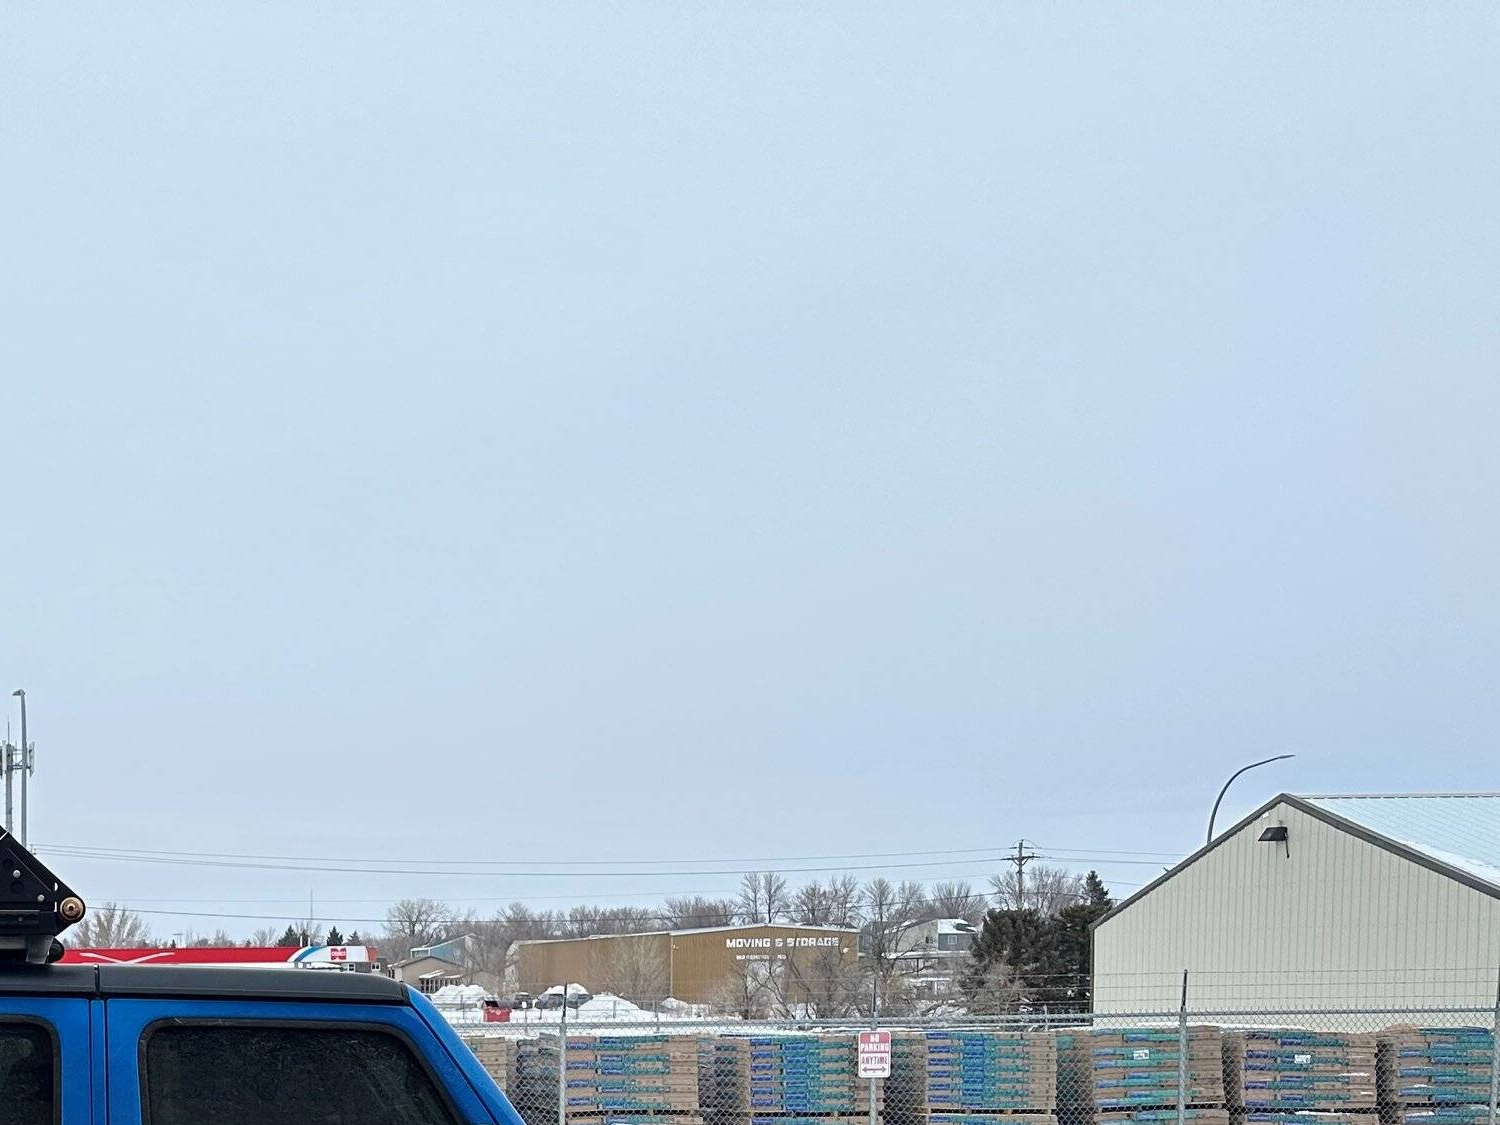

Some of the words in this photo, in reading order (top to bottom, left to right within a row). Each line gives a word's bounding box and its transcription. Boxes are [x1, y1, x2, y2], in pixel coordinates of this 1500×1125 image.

[726, 938, 771, 948] MOVING
[775, 938, 784, 947] &
[786, 937, 839, 947] STORAGE
[869, 1033, 880, 1043] NO
[860, 1042, 890, 1051] PARKING
[861, 1056, 888, 1064] ANYTIME
